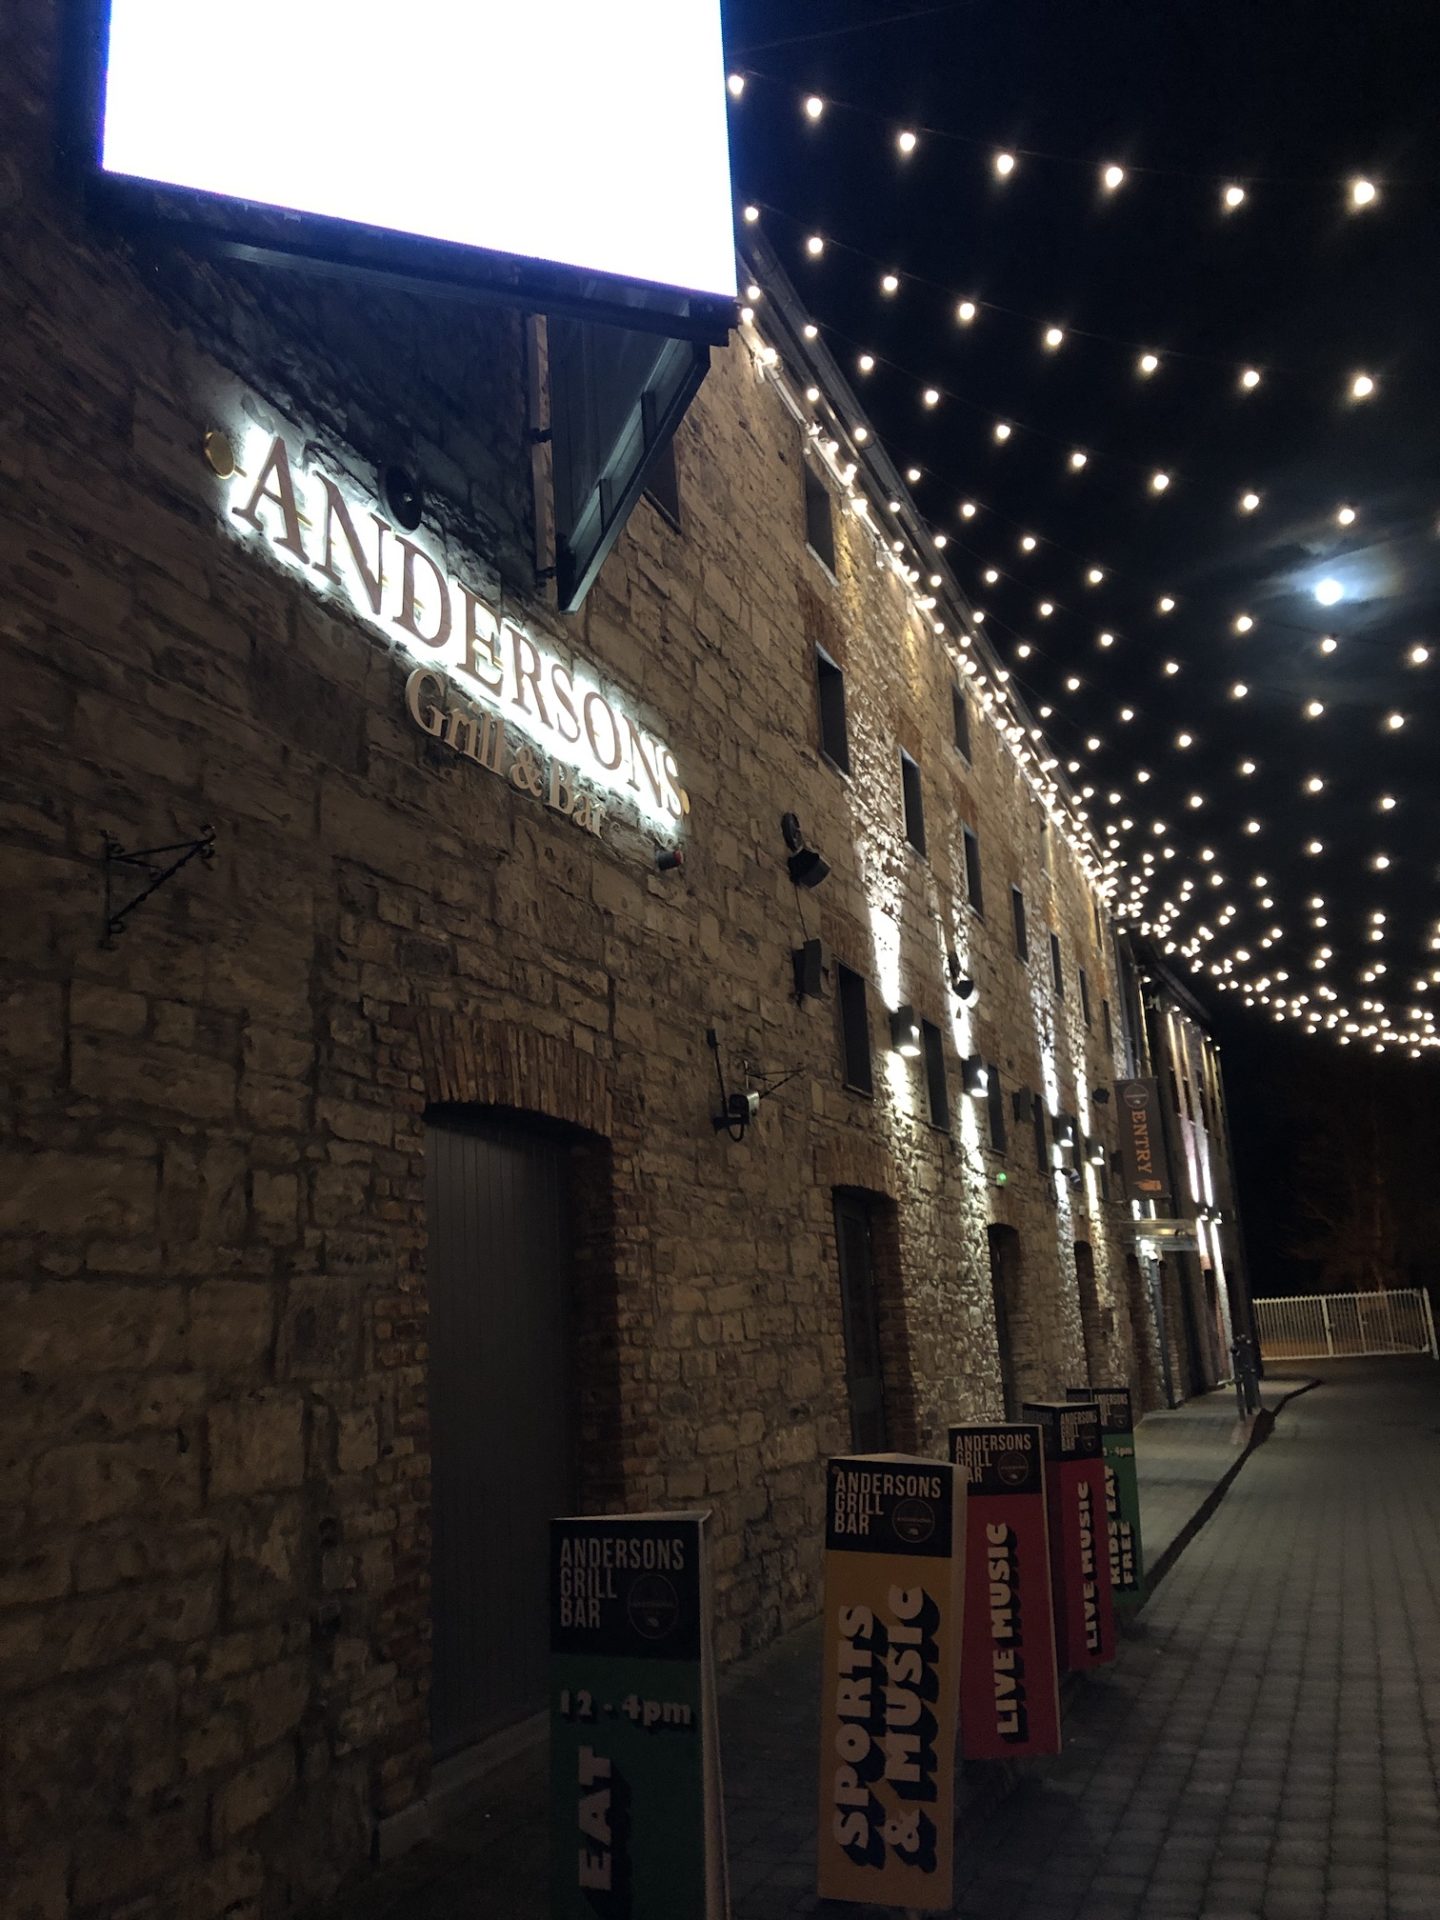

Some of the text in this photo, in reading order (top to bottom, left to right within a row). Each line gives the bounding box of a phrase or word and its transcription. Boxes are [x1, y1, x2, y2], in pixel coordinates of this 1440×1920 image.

[232, 437, 684, 820] ANDERSONS
[405, 668, 606, 840] Grill & Bar
[1131, 1109, 1152, 1174] ENTRY
[955, 1433, 1032, 1451] ANDERSONS
[955, 1449, 992, 1467] GRILL
[834, 1492, 885, 1516] GRILL
[835, 1471, 942, 1499] ANDERSONS
[560, 1536, 685, 1571] ANDERSONS
[834, 1512, 870, 1536] BAR
[1107, 1520, 1121, 1585] KIDS
[1120, 1520, 1133, 1585] FREE
[560, 1566, 618, 1599] GRILL
[1077, 1480, 1098, 1650] LIVE MUSIC
[560, 1598, 601, 1629] BAR
[986, 1522, 1019, 1733] LIVE MUSIC
[560, 1690, 593, 1717] 12
[621, 1694, 691, 1727] 4pm
[833, 1605, 875, 1849] SPORTS
[884, 1584, 926, 1853] & MUSIC
[578, 1745, 612, 1891] EAT
